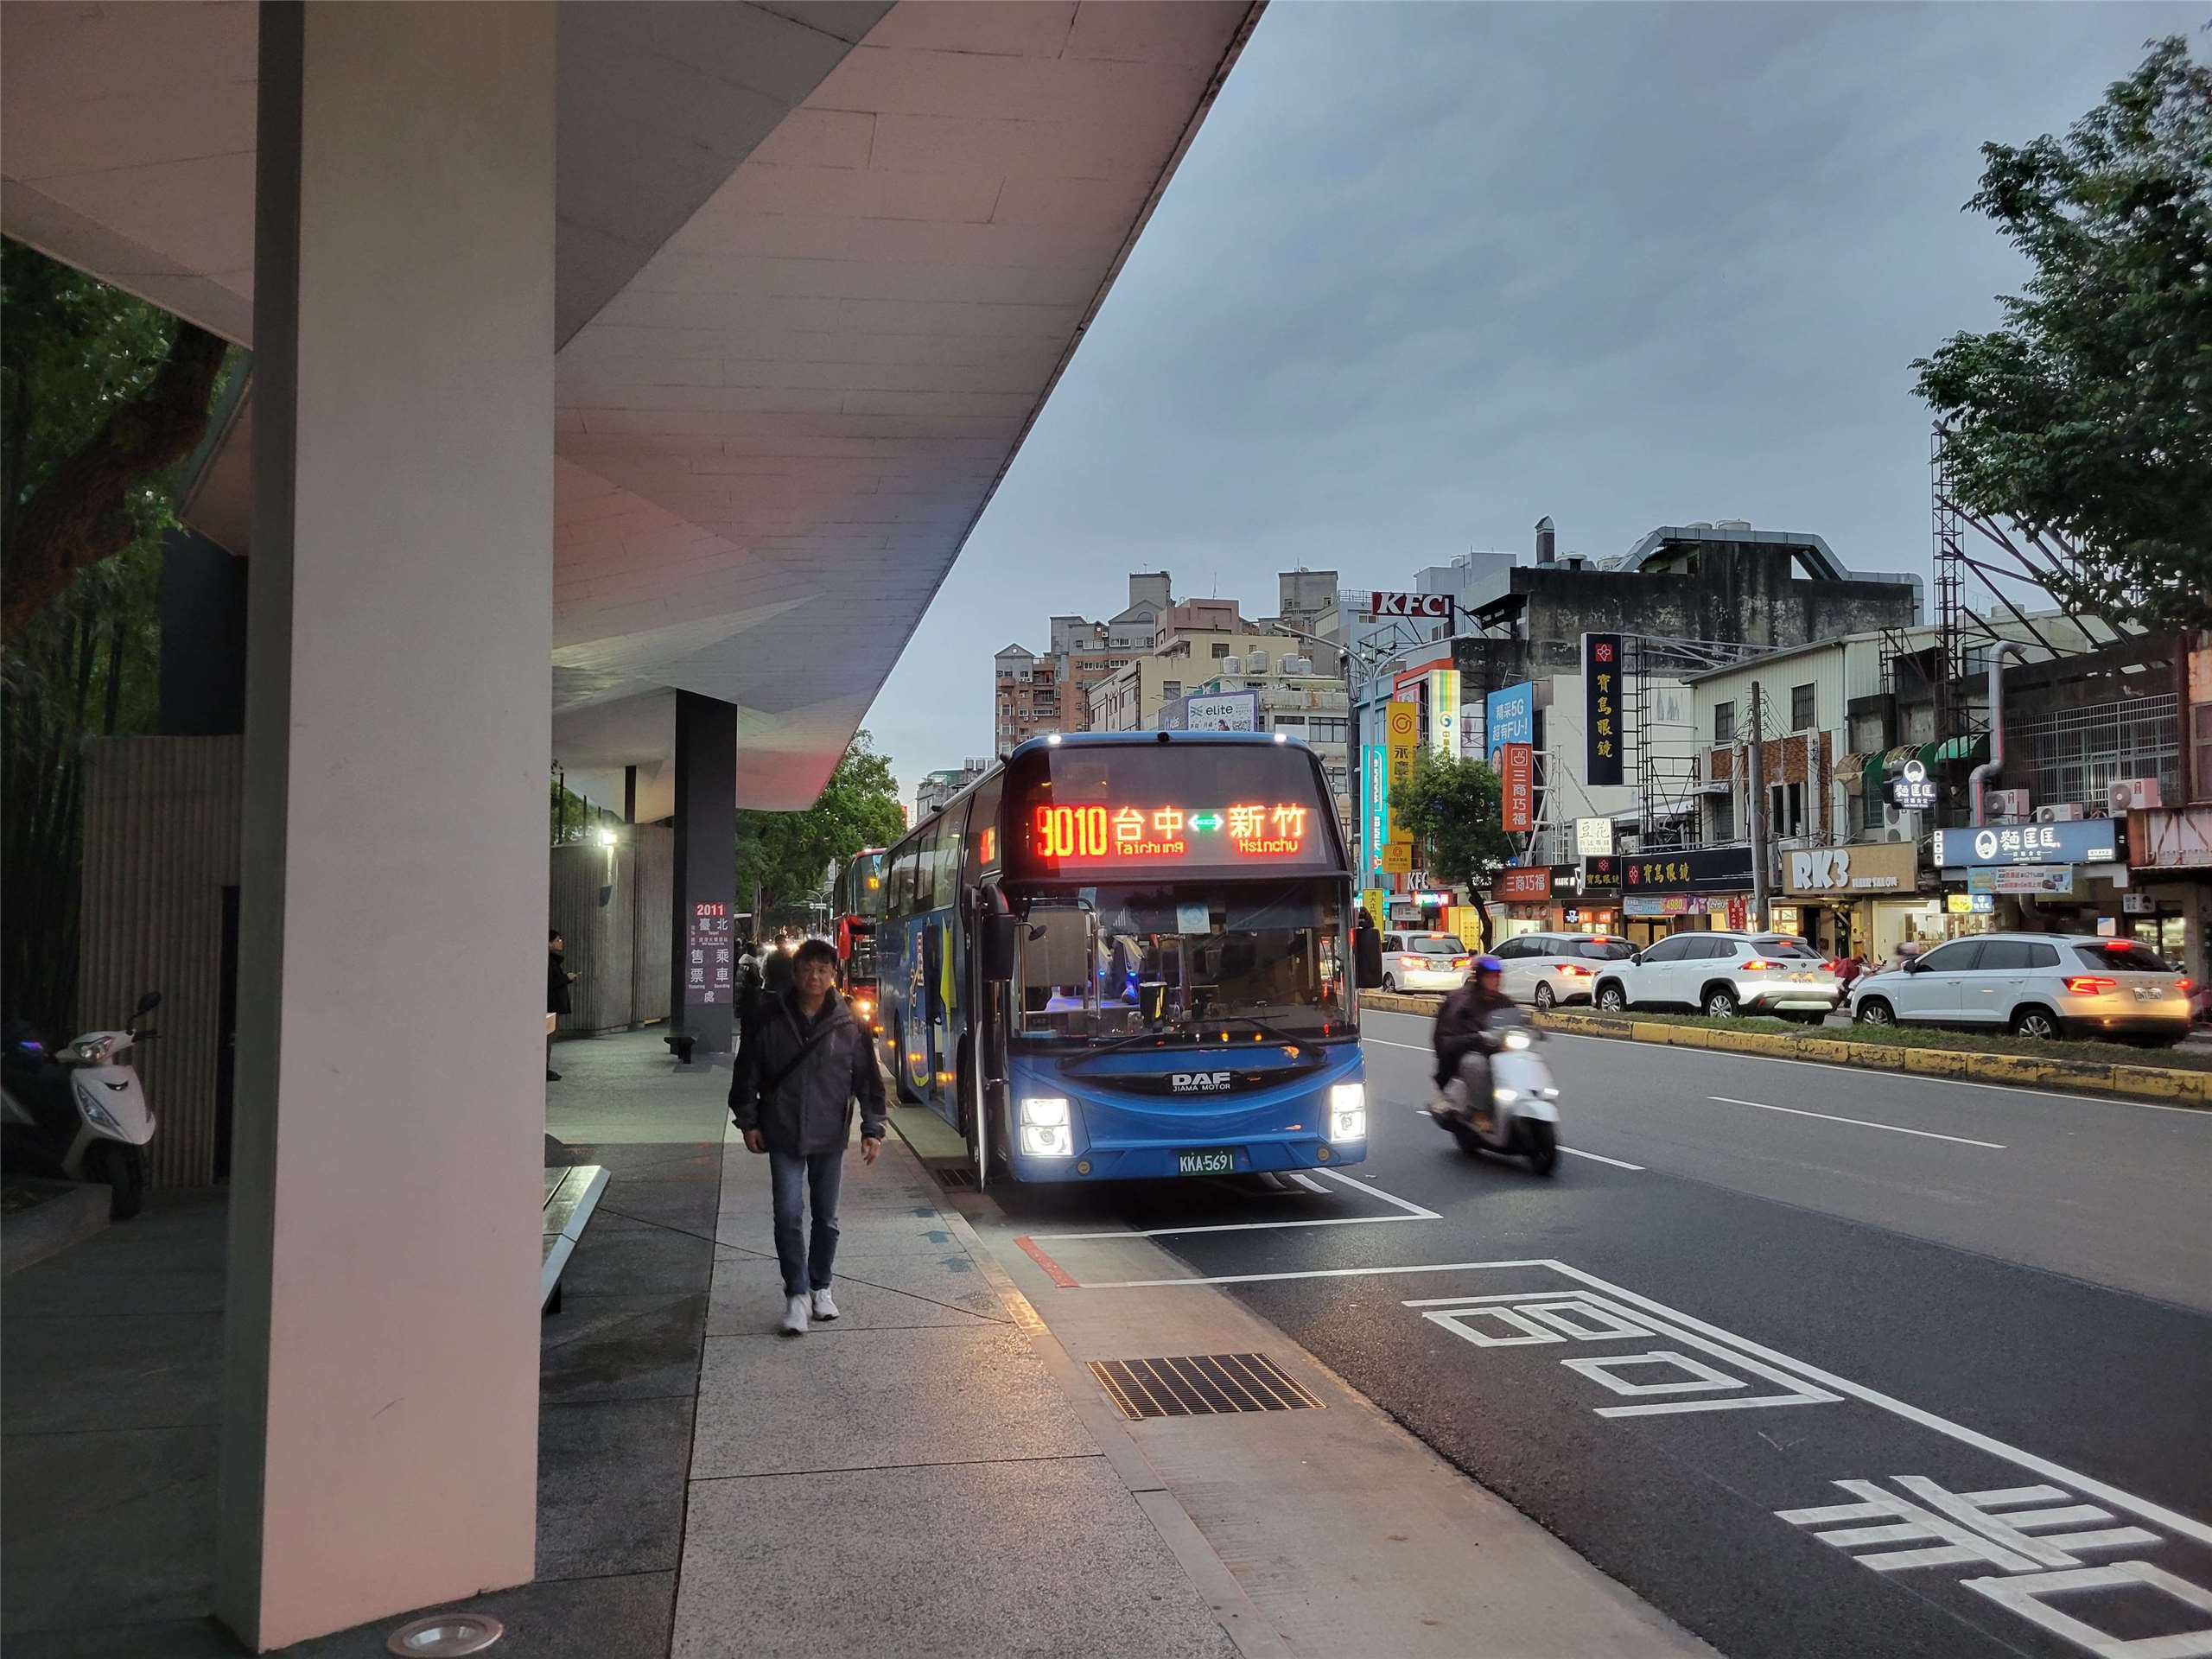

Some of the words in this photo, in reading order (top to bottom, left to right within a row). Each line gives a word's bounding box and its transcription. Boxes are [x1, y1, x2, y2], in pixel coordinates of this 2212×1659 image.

[1376, 593, 1443, 616] KFC
[1205, 704, 1233, 716] elite
[1597, 673, 1613, 758] 寶島眼鏡
[1513, 769, 1527, 825] 三商巧福
[1113, 805, 1184, 840] 台中
[1229, 803, 1306, 838] 新竹
[1239, 838, 1298, 853] Hsinchu
[1999, 827, 2058, 851] 麵匡匡
[1407, 871, 1430, 891] KFC
[1643, 862, 1690, 885] 寶島眼鏡
[1792, 849, 1850, 890] RK3
[1506, 874, 1545, 892] 三商巧福
[696, 904, 724, 916] 2011
[690, 949, 704, 983] 售票
[715, 949, 729, 982] 乘車
[1172, 1072, 1230, 1086] DAF
[1202, 1083, 1231, 1092] MOTOR
